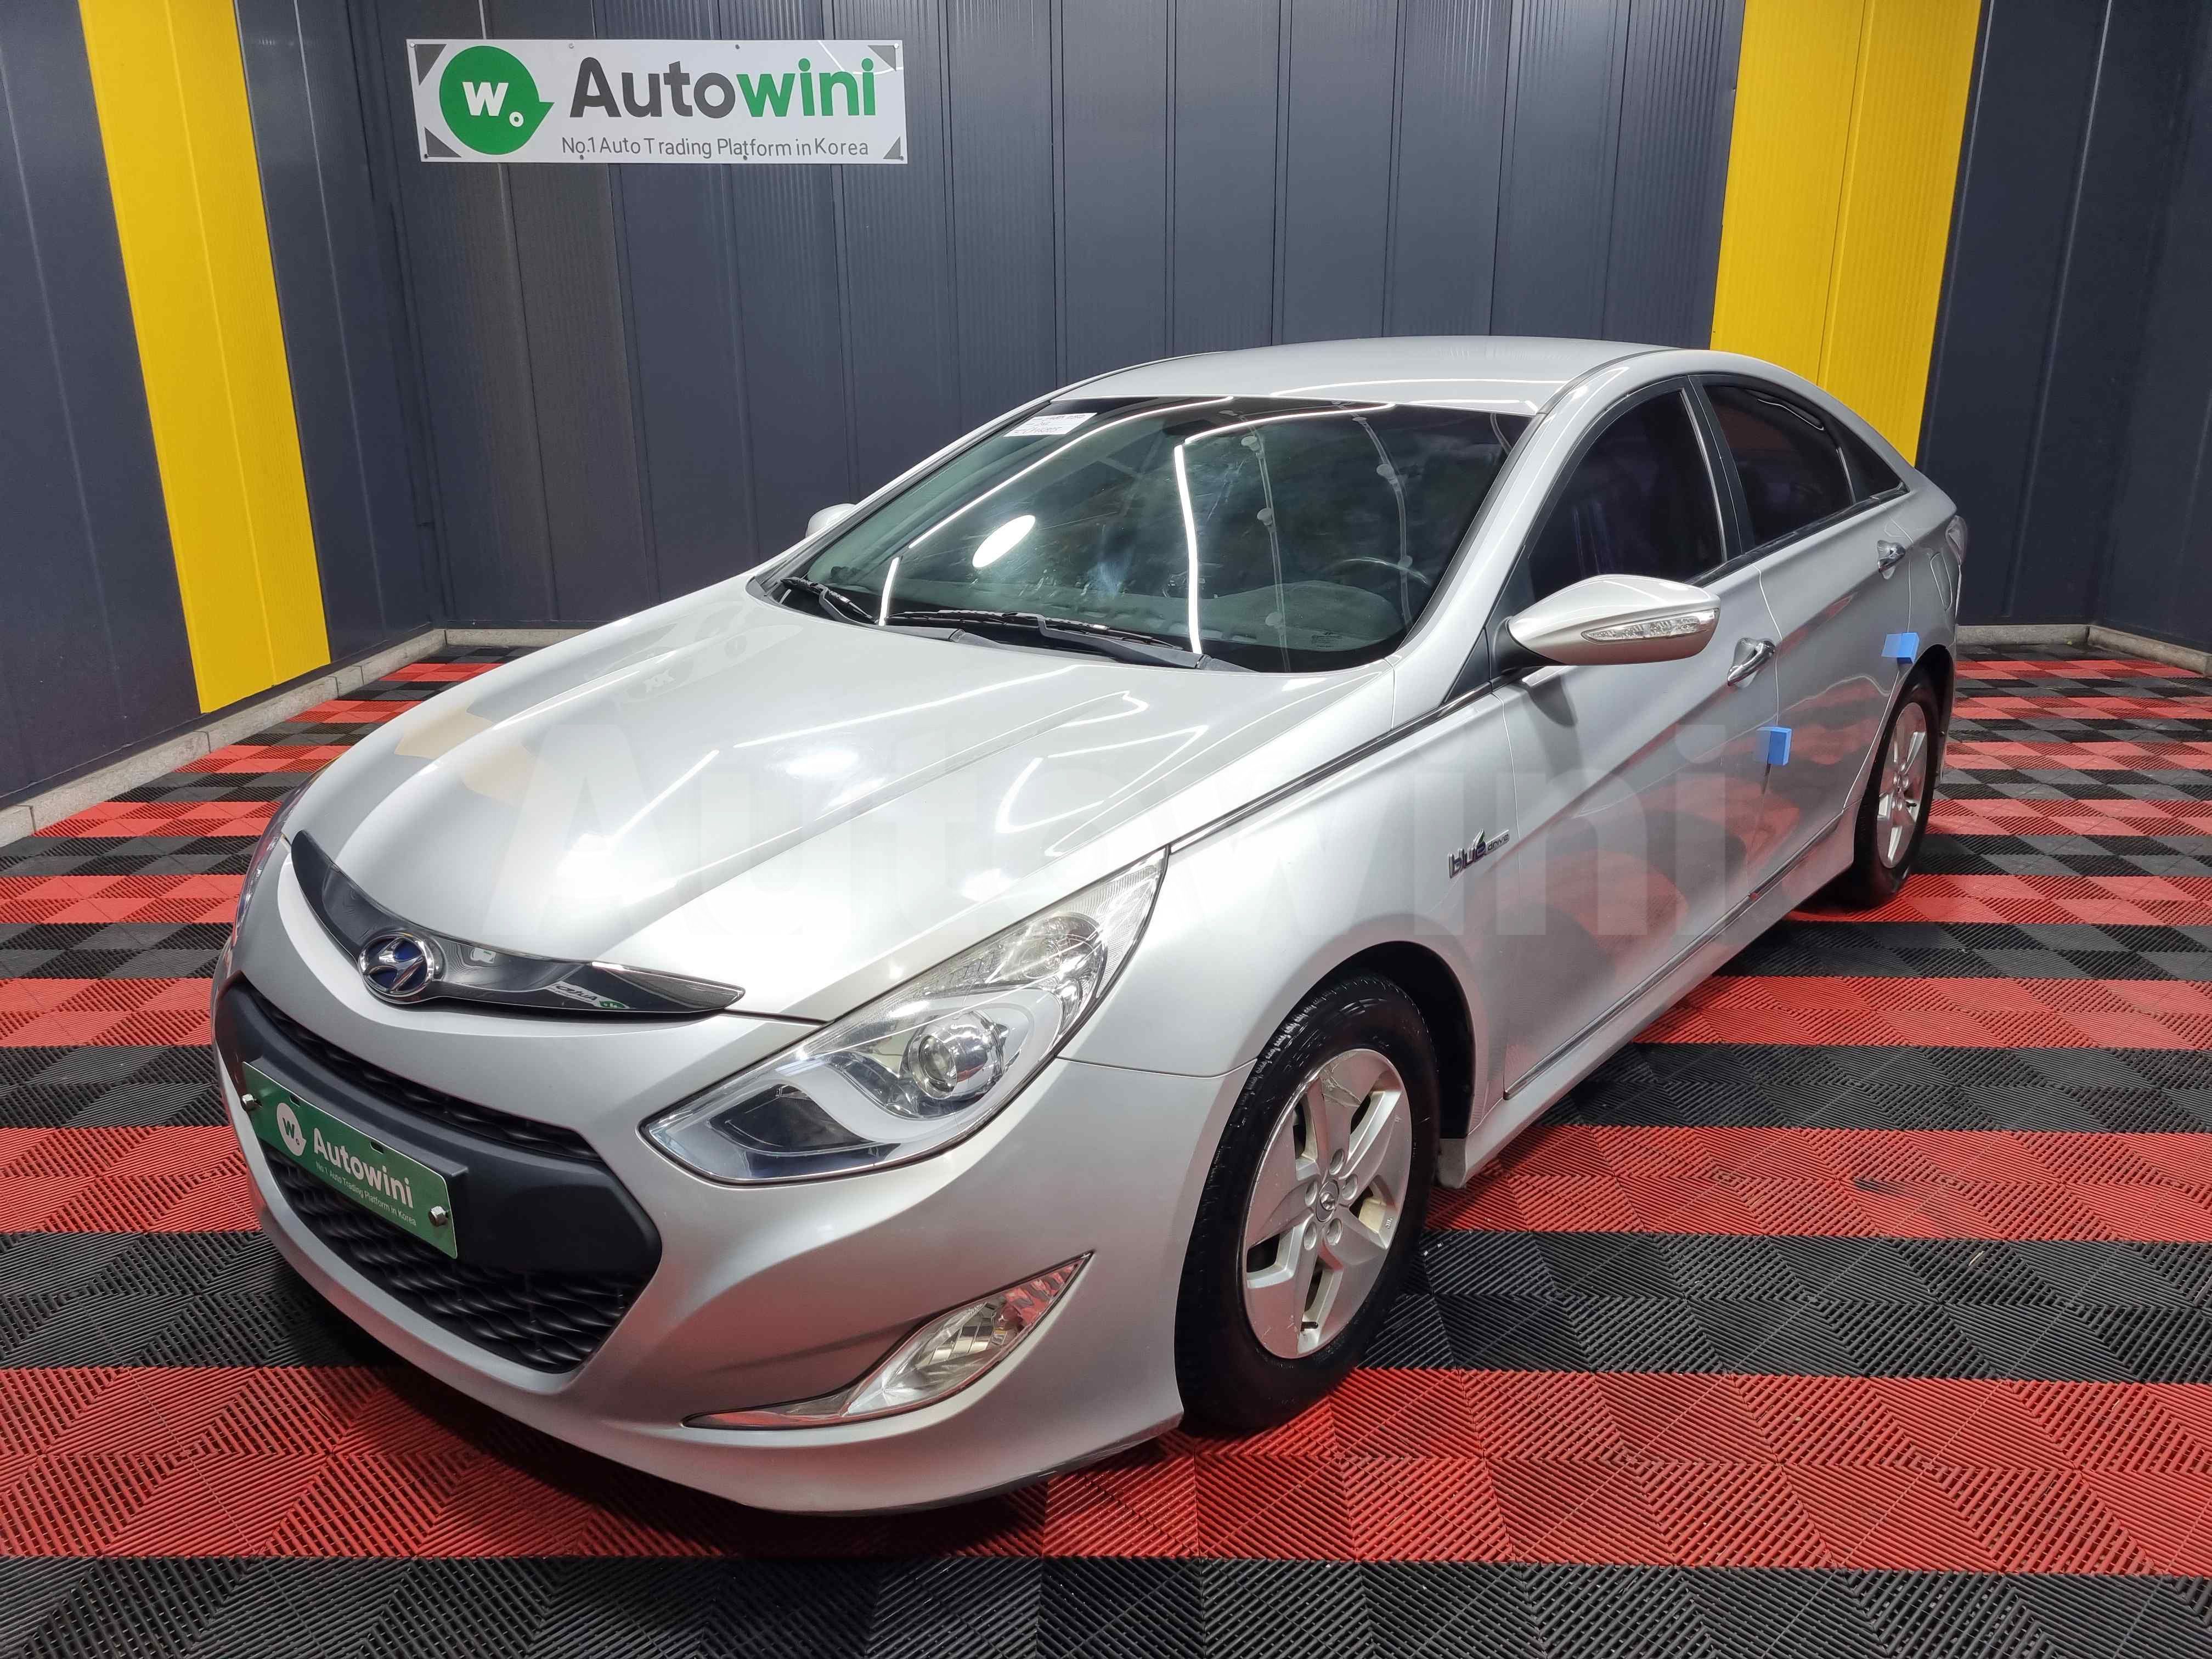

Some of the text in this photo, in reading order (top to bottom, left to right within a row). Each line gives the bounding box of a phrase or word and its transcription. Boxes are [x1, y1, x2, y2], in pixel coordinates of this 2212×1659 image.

[569, 57, 876, 119] Autowini
[562, 137, 868, 159] No.1 Auto Trading Platform in Korea
[1448, 829, 1509, 879] blue drive
[314, 1127, 413, 1209] Autowini
[329, 1170, 342, 1184] Auto
[341, 1177, 364, 1199] Trading
[364, 1190, 391, 1212] Platform
[397, 1207, 417, 1227] Korea
